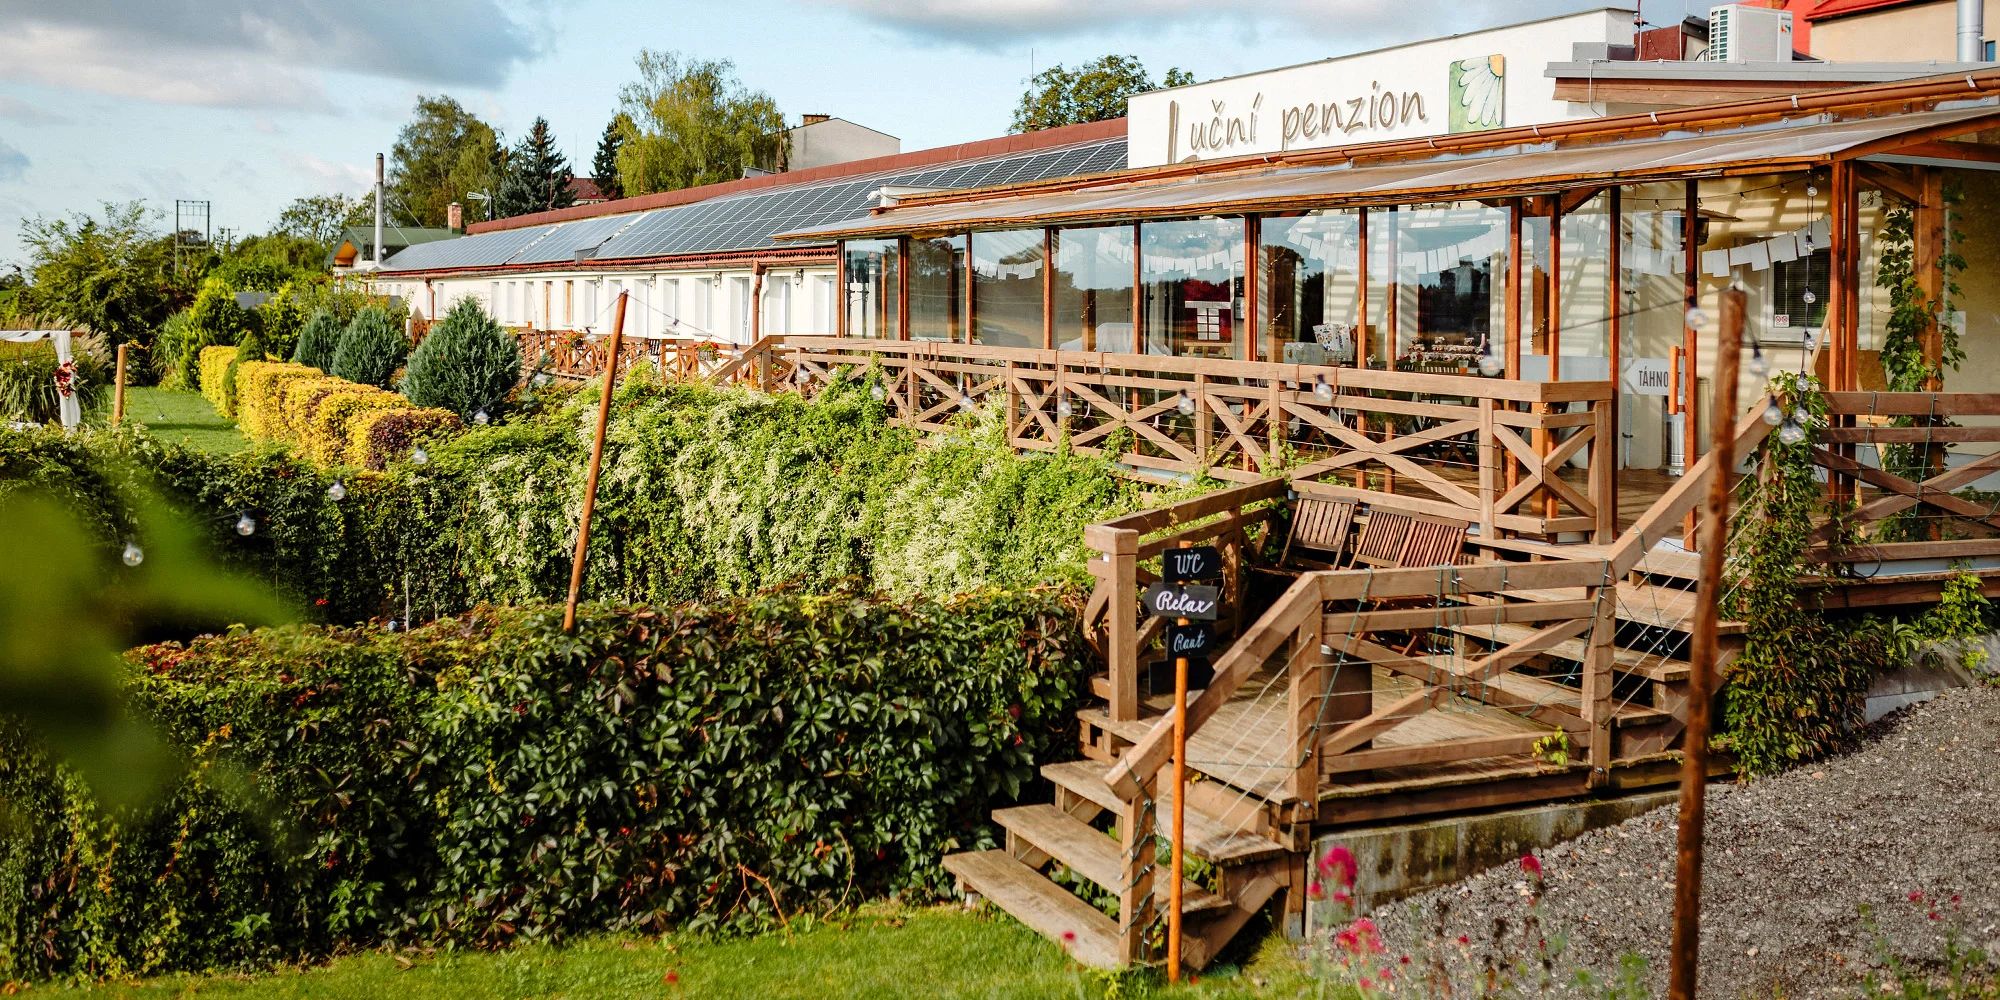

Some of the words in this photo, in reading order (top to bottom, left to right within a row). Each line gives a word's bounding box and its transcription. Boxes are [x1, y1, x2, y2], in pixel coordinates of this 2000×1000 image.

[1282, 81, 1425, 152] penzion
[1639, 366, 1681, 388] TÁHNOT
[1174, 553, 1204, 575] WC
[1156, 590, 1214, 613] Relax
